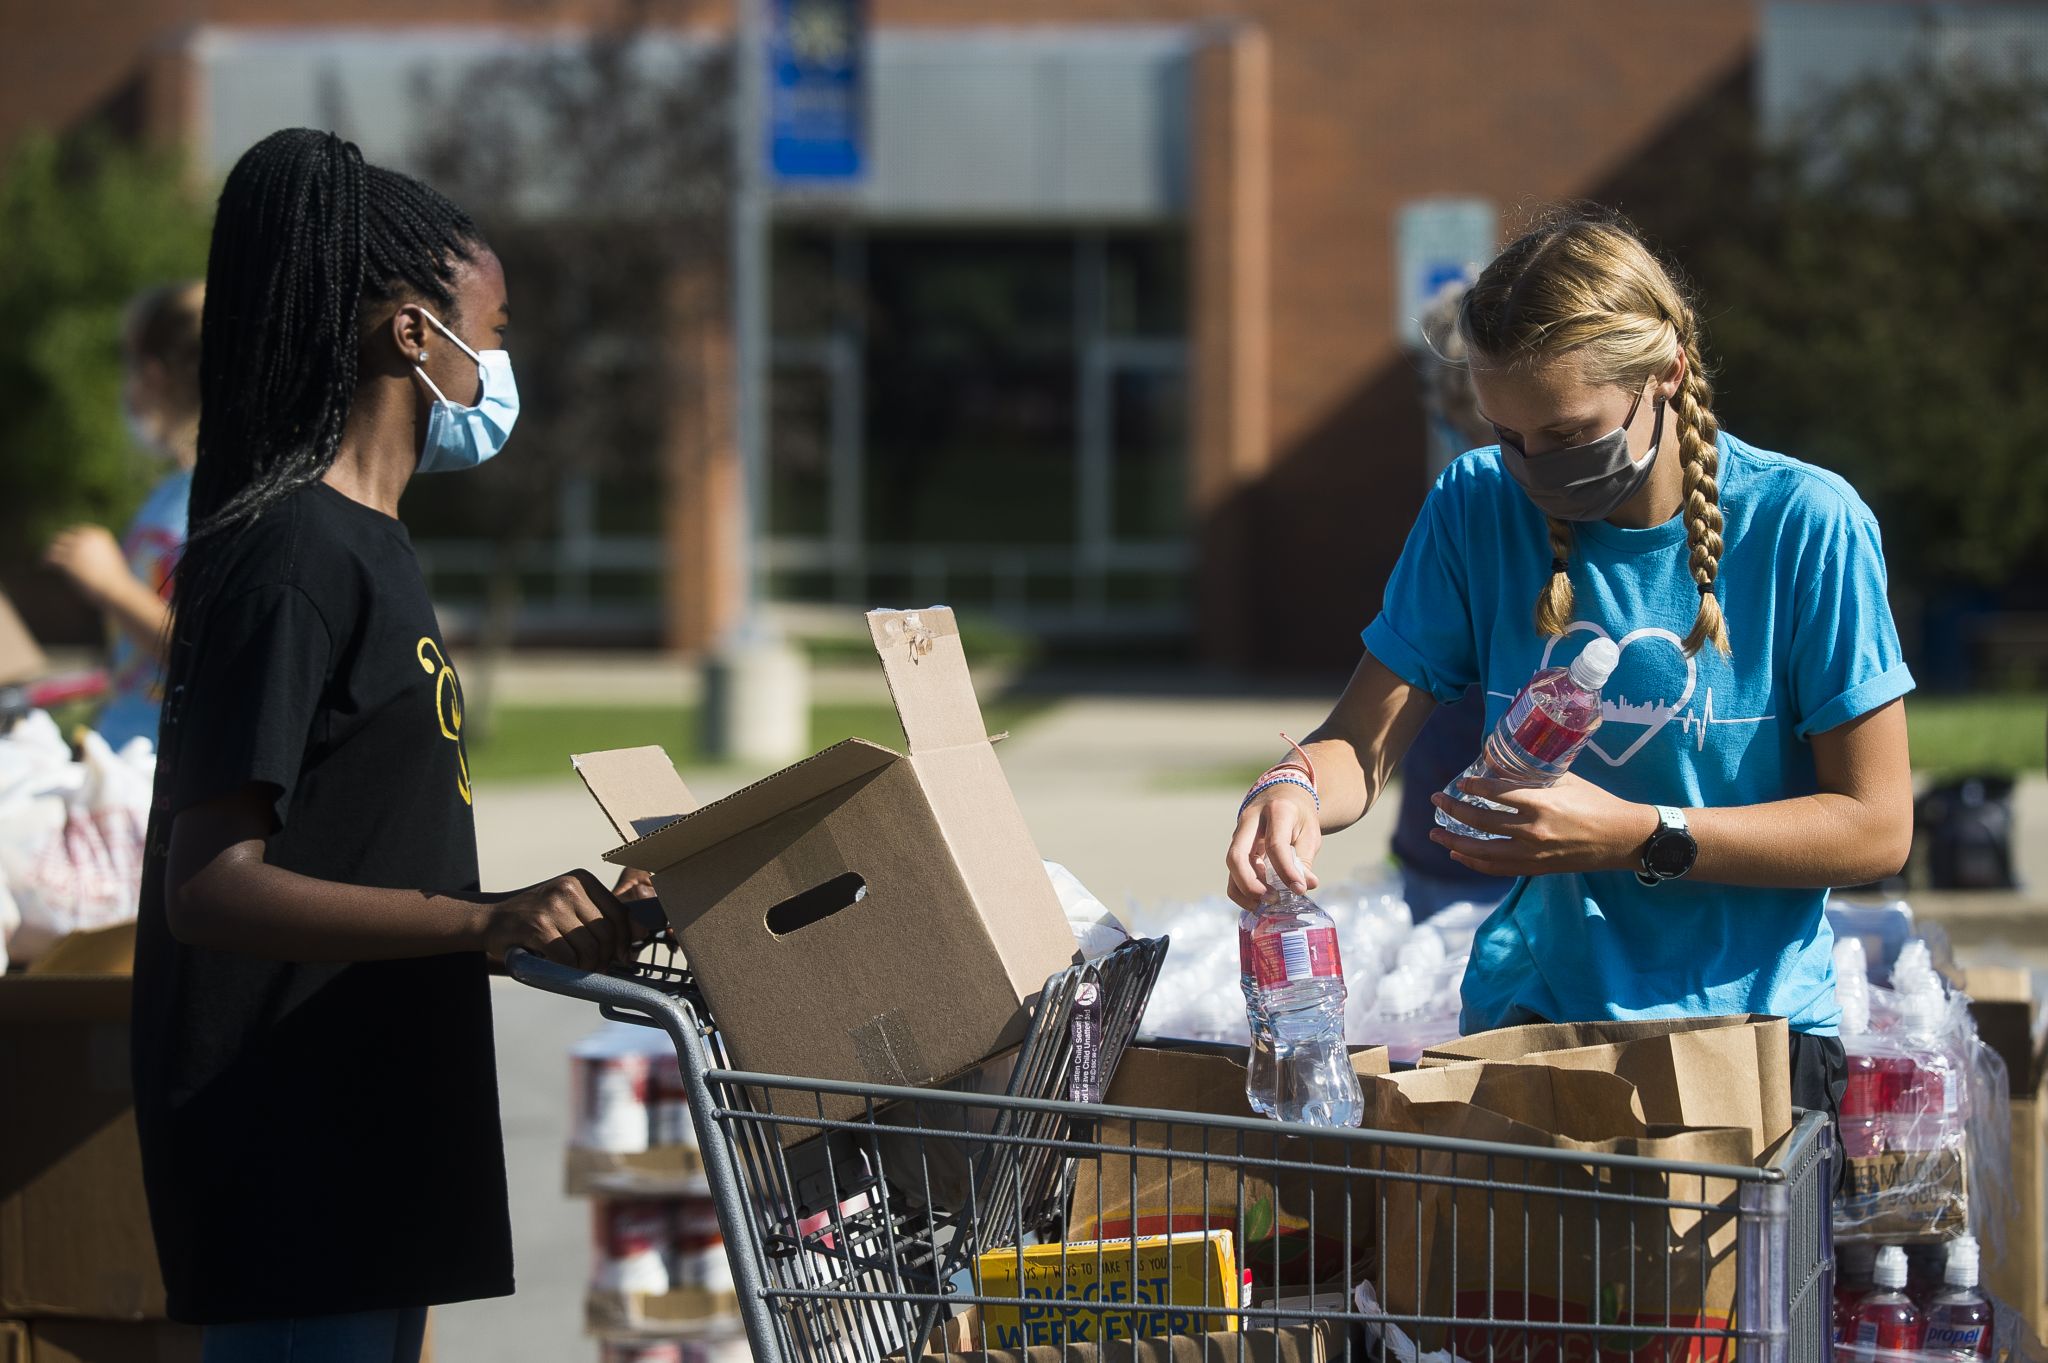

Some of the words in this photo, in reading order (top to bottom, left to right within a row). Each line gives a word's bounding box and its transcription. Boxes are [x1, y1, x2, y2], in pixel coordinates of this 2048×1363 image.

[1075, 1014, 1083, 1043] Securly
[1074, 1045, 1082, 1064] Child
[1082, 1051, 1090, 1070] Child
[1053, 1264, 1077, 1279] WYS
[1081, 1262, 1093, 1275] TO
[1023, 1277, 1169, 1320] BIGGEST
[1927, 1327, 1980, 1345] propel
